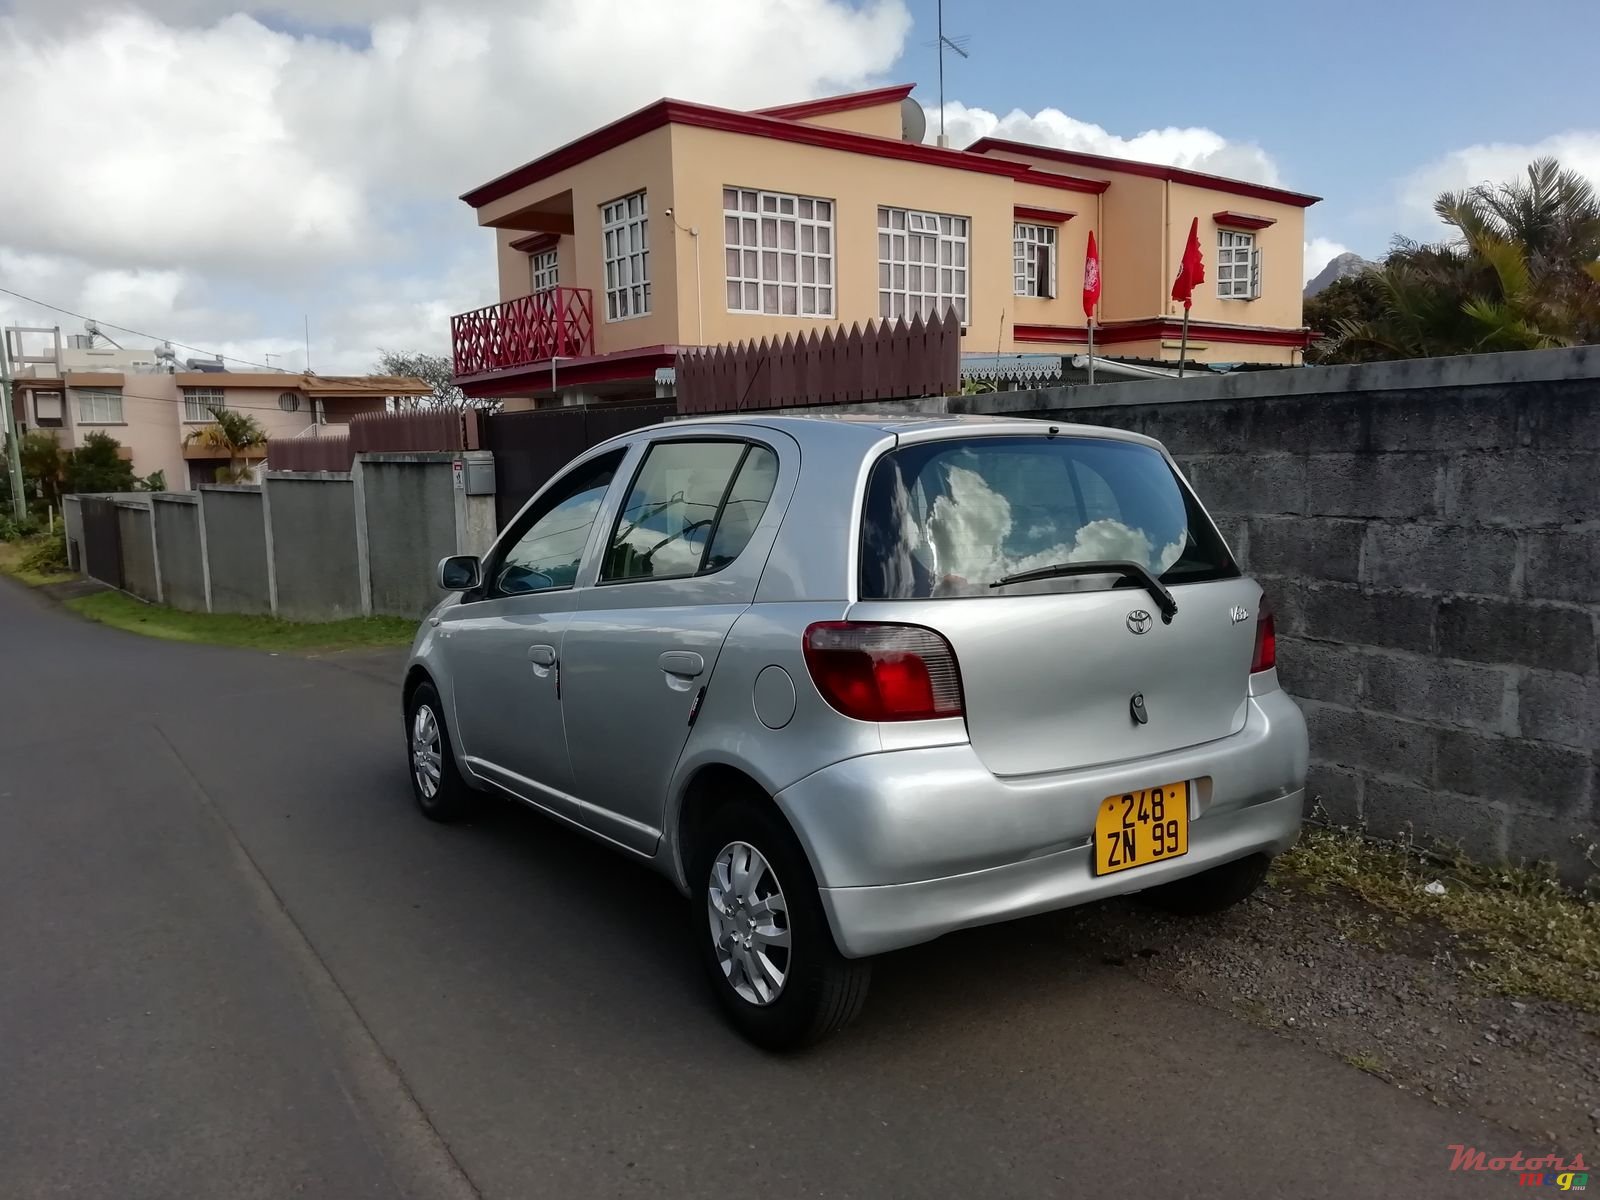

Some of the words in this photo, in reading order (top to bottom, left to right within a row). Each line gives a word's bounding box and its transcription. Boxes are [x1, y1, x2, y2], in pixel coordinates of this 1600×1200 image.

[1121, 788, 1165, 829] 248
[1107, 828, 1136, 867] ZN
[1152, 819, 1179, 857] 99
